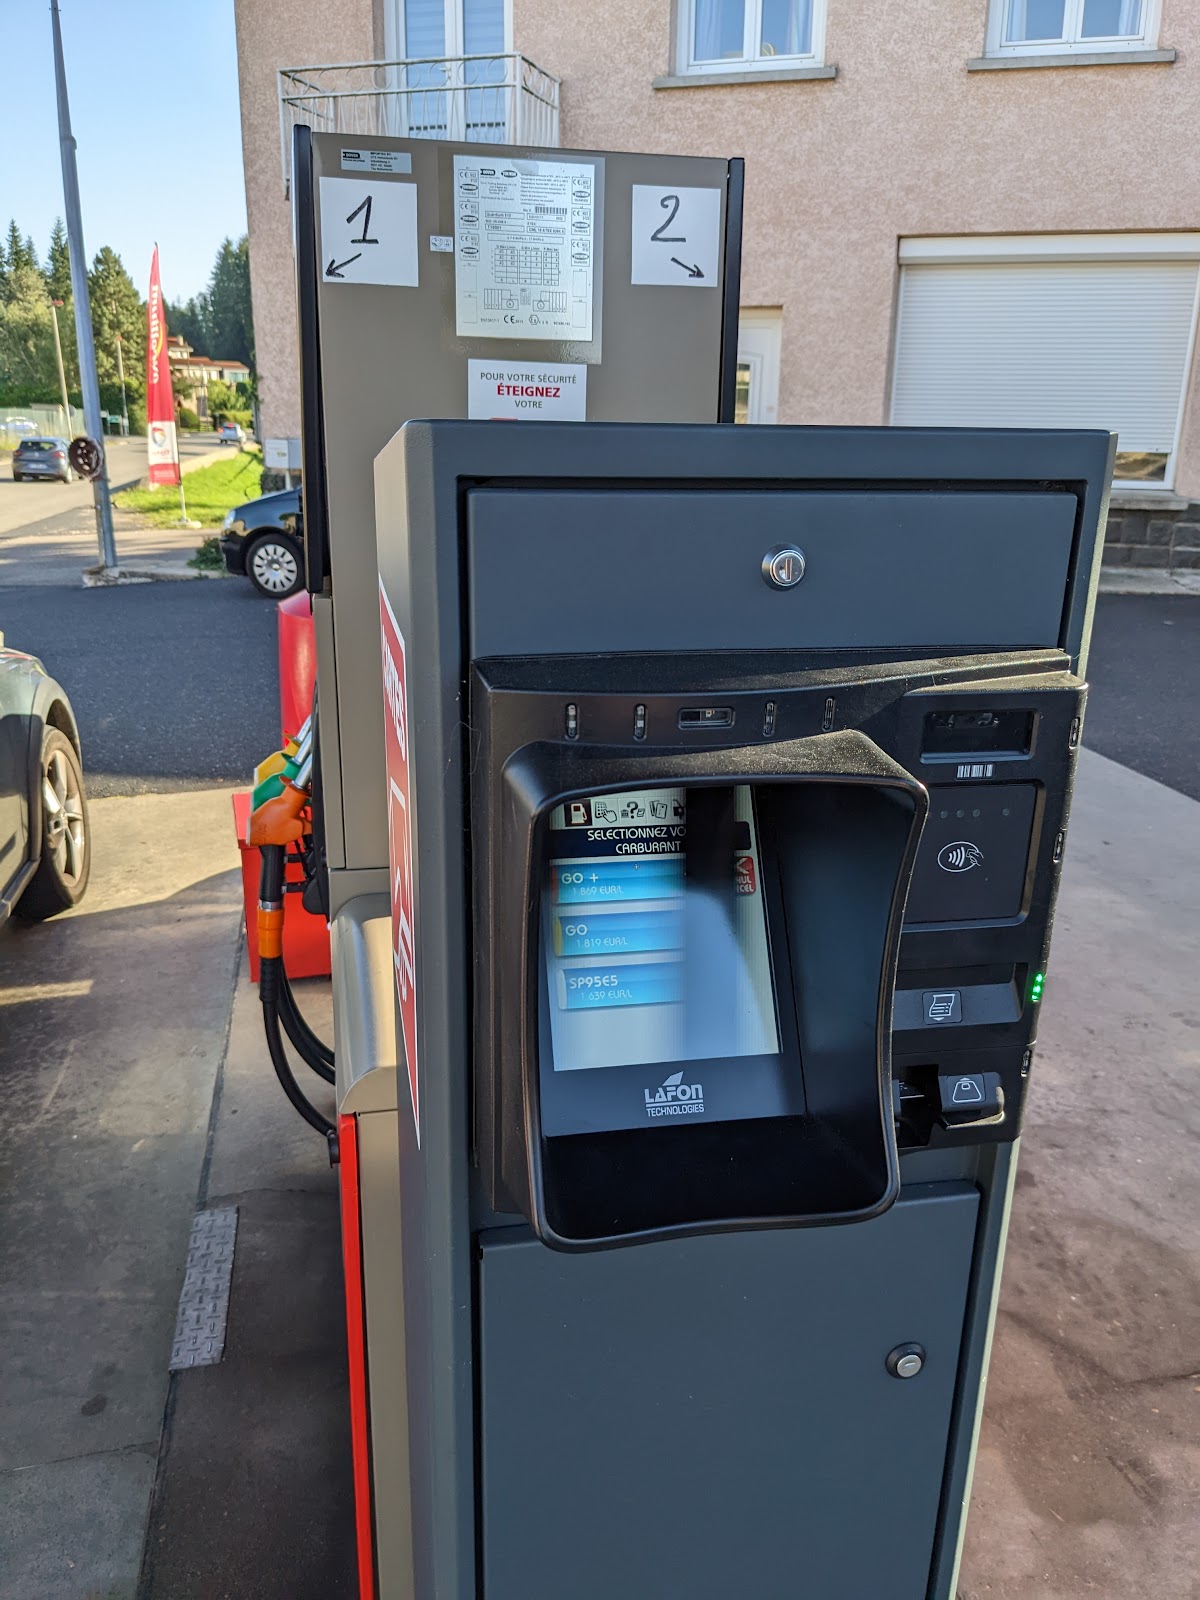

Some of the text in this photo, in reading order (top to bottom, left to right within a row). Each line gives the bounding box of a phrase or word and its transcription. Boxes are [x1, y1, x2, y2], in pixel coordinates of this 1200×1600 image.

[346, 195, 379, 244] 1
[651, 195, 686, 242] 2
[480, 372, 576, 384] POUR VOTRE SÉCURITÉ
[497, 383, 560, 398] ÉTEIGNEZ
[515, 400, 542, 408] VOTRE
[588, 827, 667, 841] SELECTIONNEZ
[616, 841, 681, 854] CARBURANT
[562, 873, 583, 884] GO
[565, 924, 587, 936] GO
[569, 975, 618, 989] SP95E5
[646, 1104, 704, 1117] TECHNOLOGIES
